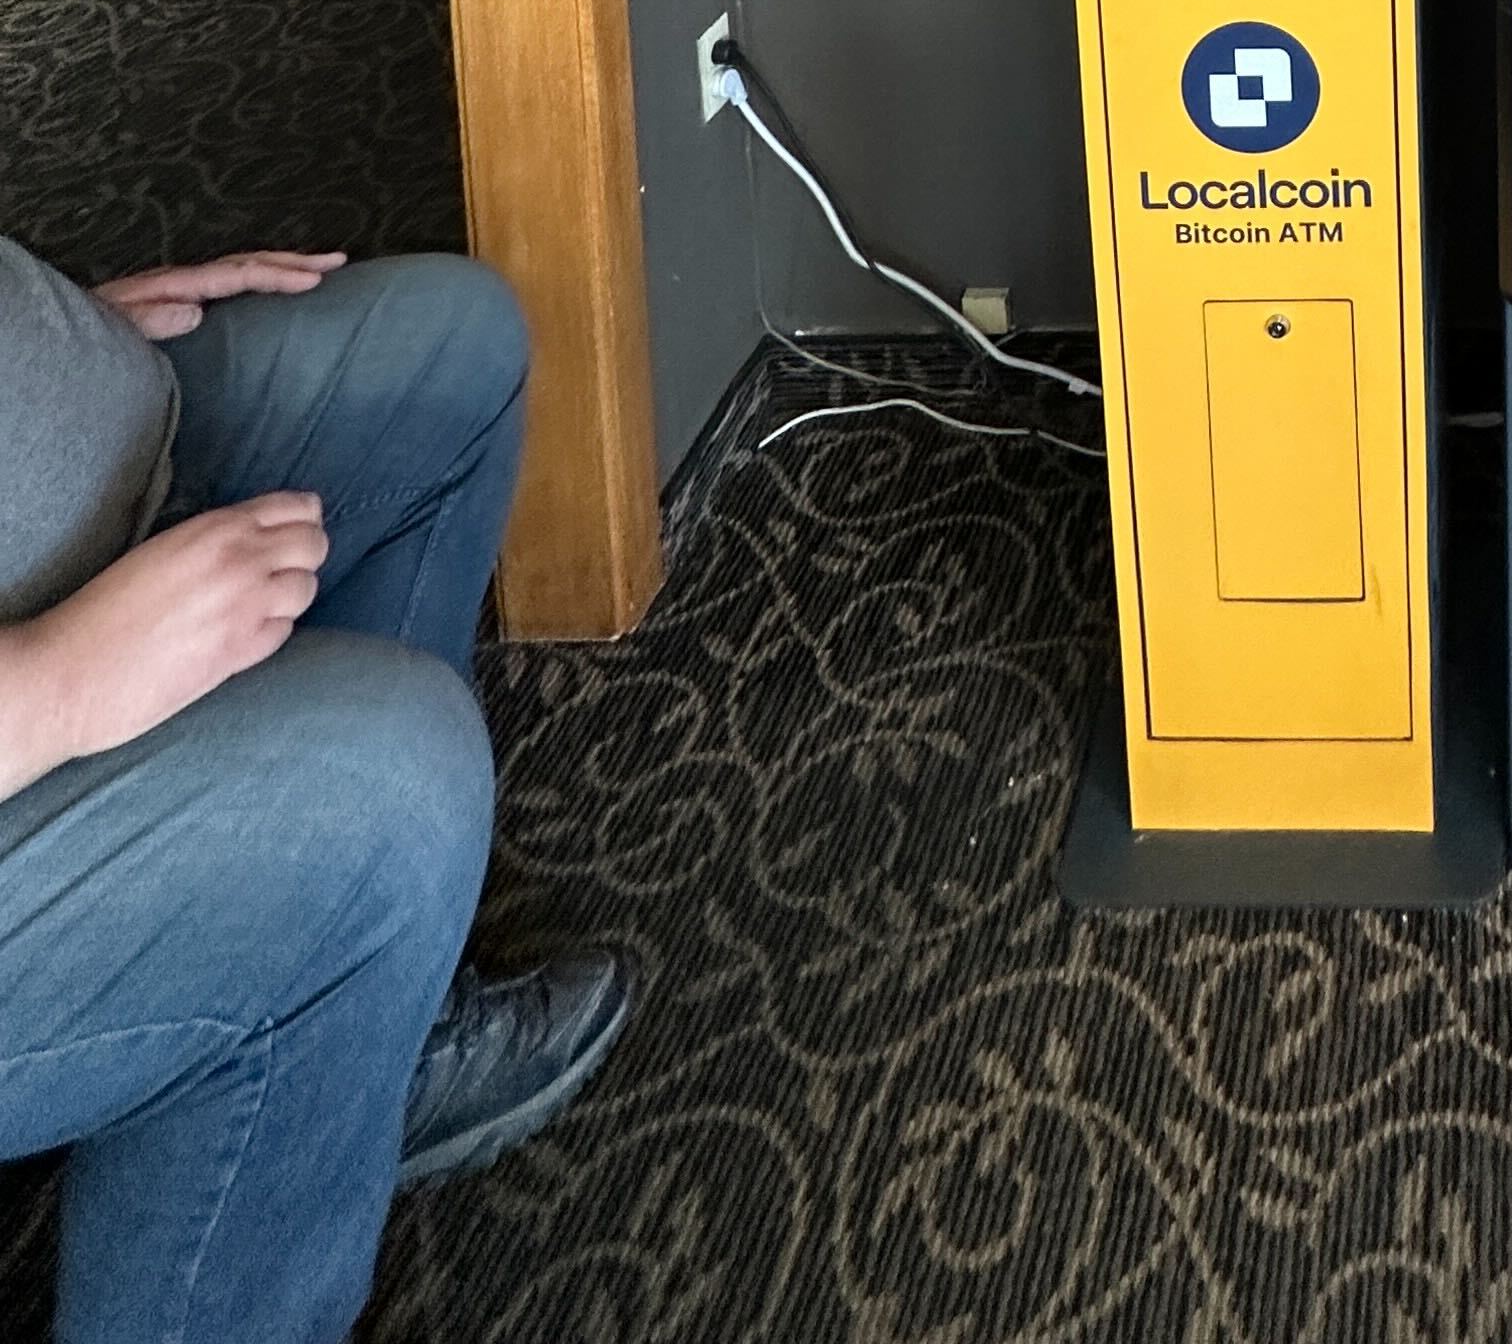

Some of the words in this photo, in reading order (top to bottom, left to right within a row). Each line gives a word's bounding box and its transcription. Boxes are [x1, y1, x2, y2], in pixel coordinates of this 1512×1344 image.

[1139, 168, 1372, 210] Localcoin
[1175, 222, 1271, 244] Bitcoin
[1279, 223, 1344, 243] ATM
